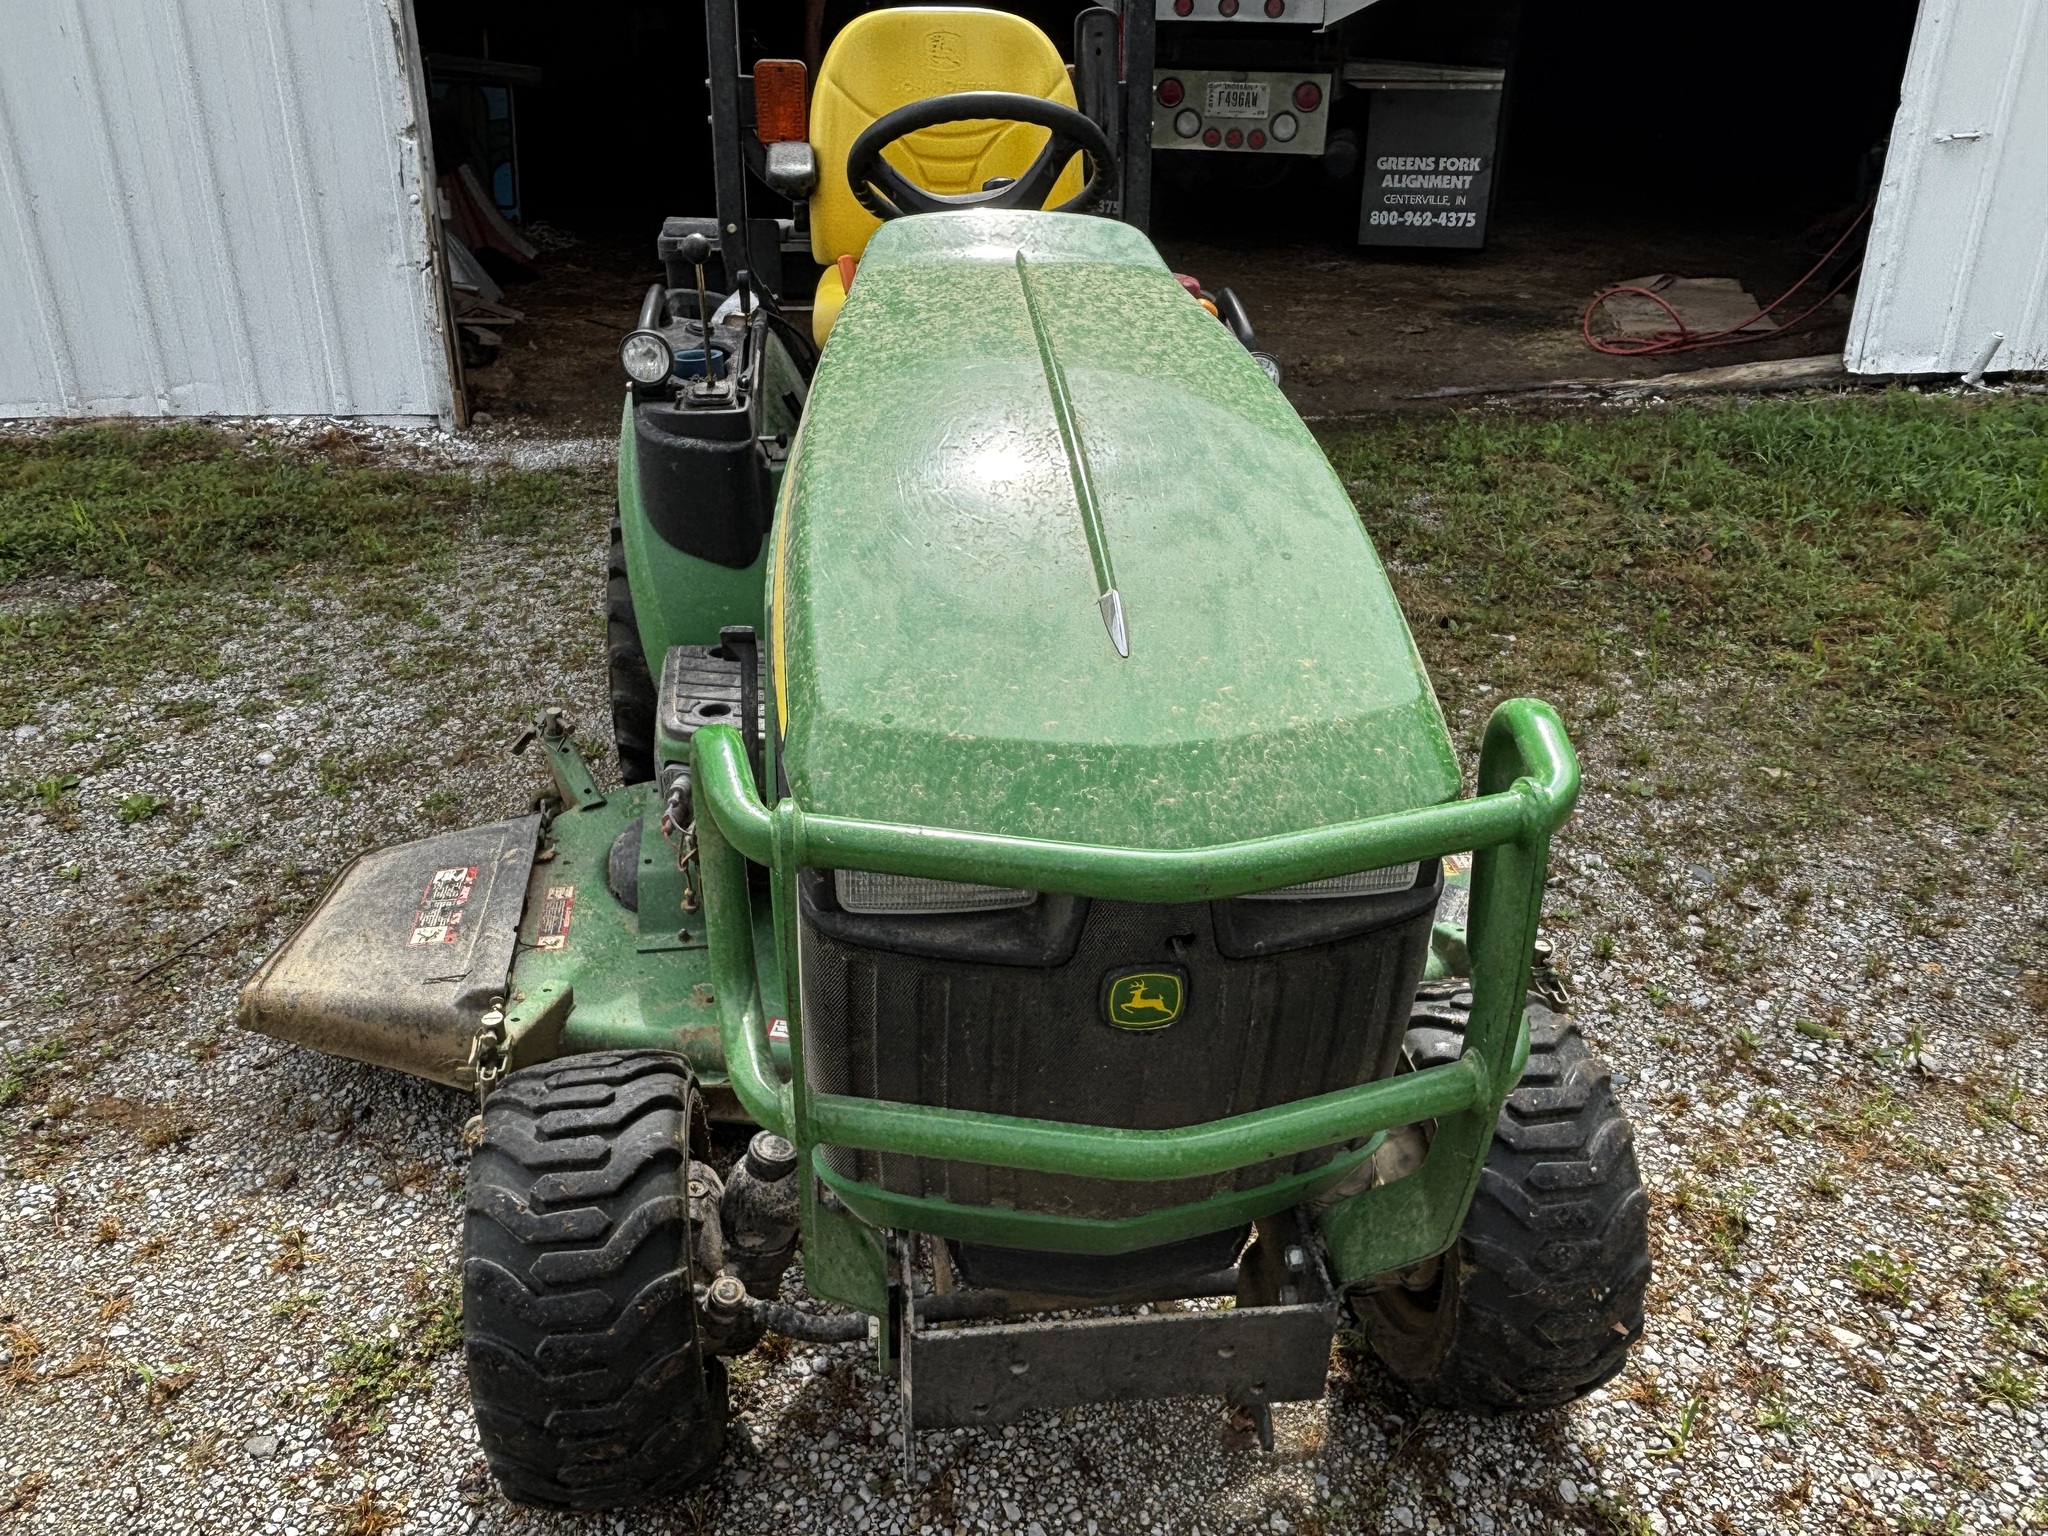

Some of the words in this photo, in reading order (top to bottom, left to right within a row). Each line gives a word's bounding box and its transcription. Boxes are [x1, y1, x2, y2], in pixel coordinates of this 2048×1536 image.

[1376, 157, 1435, 171] GREENS
[1439, 158, 1481, 171] FORK
[1382, 174, 1473, 189] ALIGNMENT
[1384, 194, 1450, 206] CENTERVILLE,
[1455, 195, 1466, 205] IN
[1370, 211, 1476, 227] 800-962-4375
